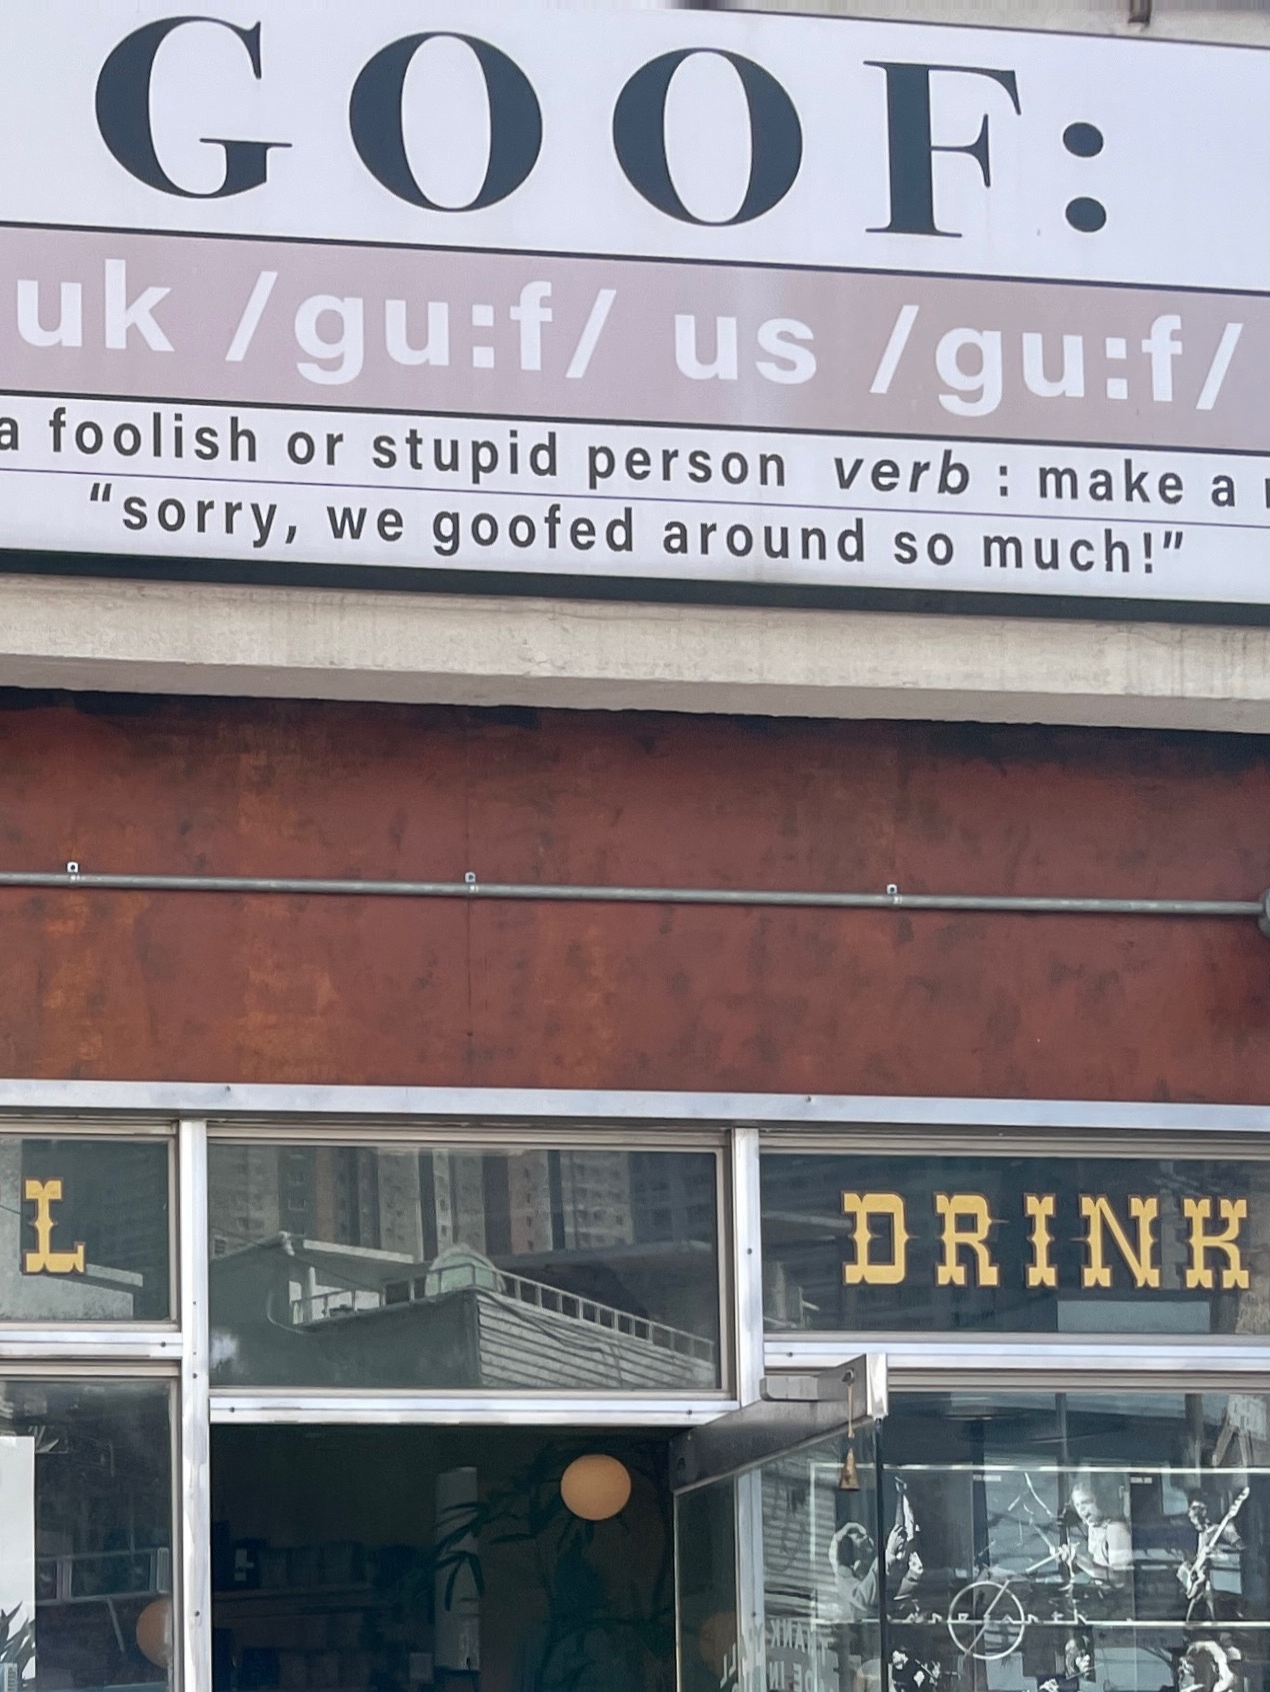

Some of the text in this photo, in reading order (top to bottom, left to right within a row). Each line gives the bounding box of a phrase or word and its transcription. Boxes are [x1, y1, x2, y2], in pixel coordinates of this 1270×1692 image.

[96, 15, 1108, 238] GOOF:
[17, 259, 175, 354] uk
[674, 313, 817, 384] us
[50, 407, 257, 464] foolish
[287, 429, 344, 467] or
[373, 429, 559, 488] stupid
[588, 443, 787, 490] person
[834, 449, 971, 498] verb
[1039, 459, 1184, 504] make
[1211, 472, 1236, 508] a
[327, 508, 404, 542] we
[433, 505, 635, 557] goofed
[662, 518, 866, 564] around
[894, 532, 955, 568] so
[841, 1190, 1253, 1290] DRINK
